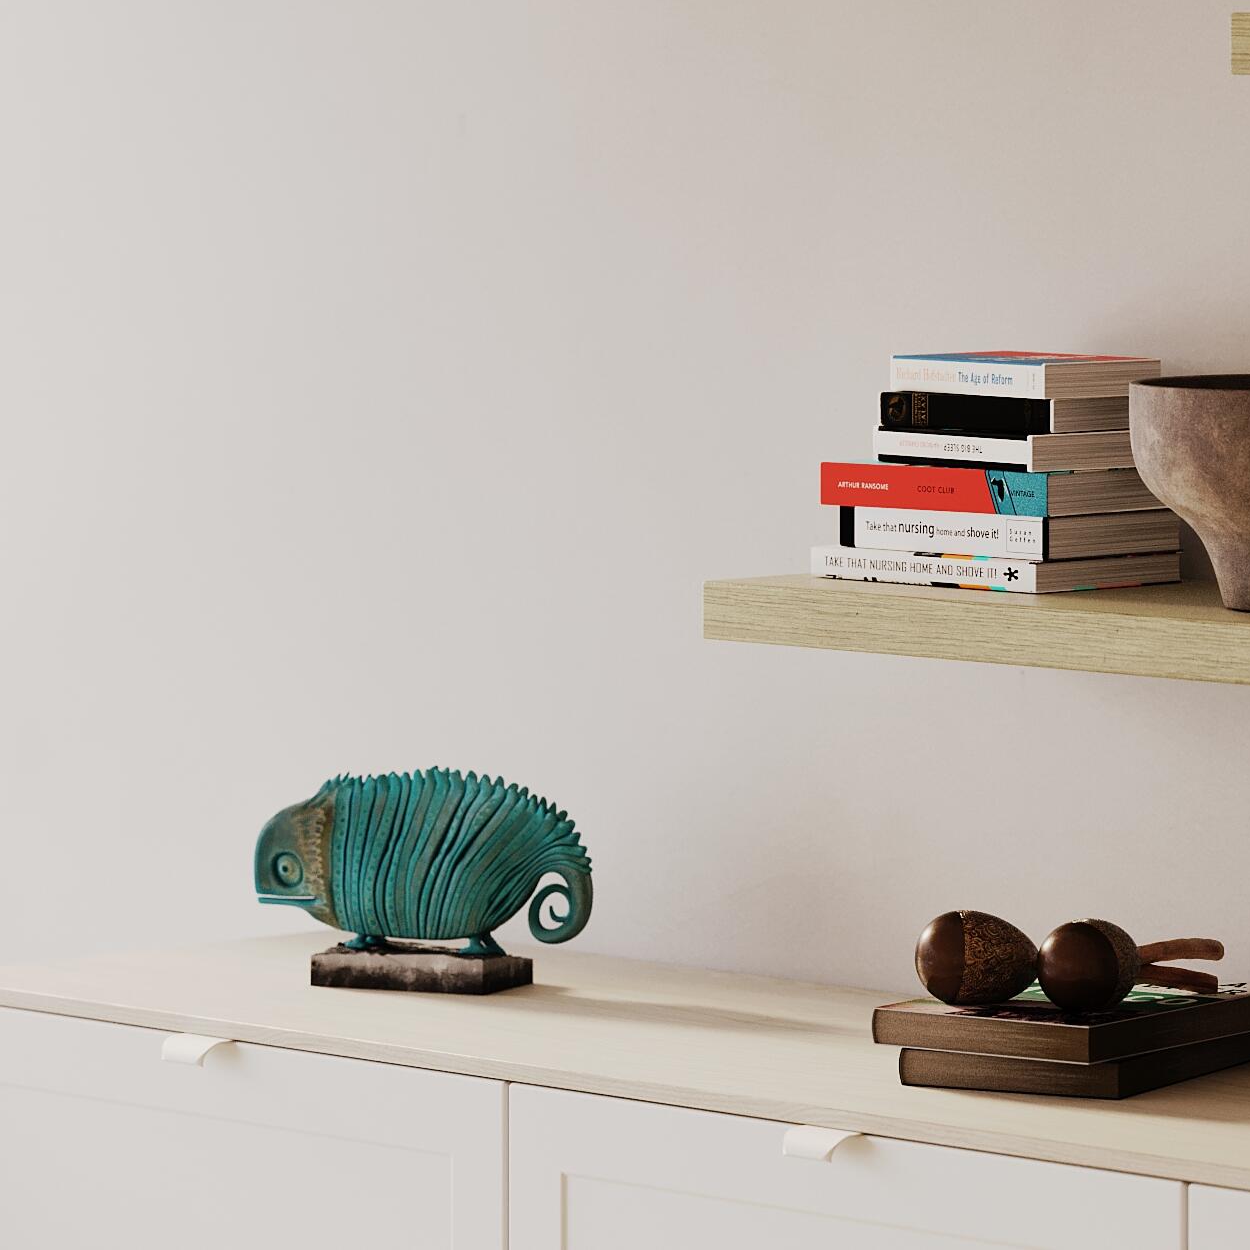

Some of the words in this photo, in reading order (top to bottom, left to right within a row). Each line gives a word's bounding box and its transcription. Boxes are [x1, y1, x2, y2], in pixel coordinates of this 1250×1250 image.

[958, 371, 969, 383] The
[970, 372, 981, 386] Age
[983, 373, 989, 384] of
[992, 373, 1013, 385] Reform
[944, 443, 960, 453] SLEEP
[961, 444, 971, 453] BIG
[972, 445, 983, 454] THE
[838, 481, 860, 489] ARTHUR
[861, 482, 889, 491] RANSOME
[917, 486, 935, 494] COOT
[1010, 490, 1035, 498] VINTAGE
[866, 520, 882, 532] Take
[882, 523, 897, 533] that
[898, 522, 935, 538] nursing
[936, 528, 952, 537] home
[954, 528, 965, 538] and
[967, 527, 990, 539] shove
[991, 528, 999, 539] it!
[825, 556, 844, 568] TAKE
[847, 558, 867, 570] THAT
[870, 560, 907, 572] NURSING
[910, 563, 933, 575] HOME
[937, 564, 953, 576] AND
[957, 566, 984, 578] SHOVE
[988, 568, 998, 579] IT!
